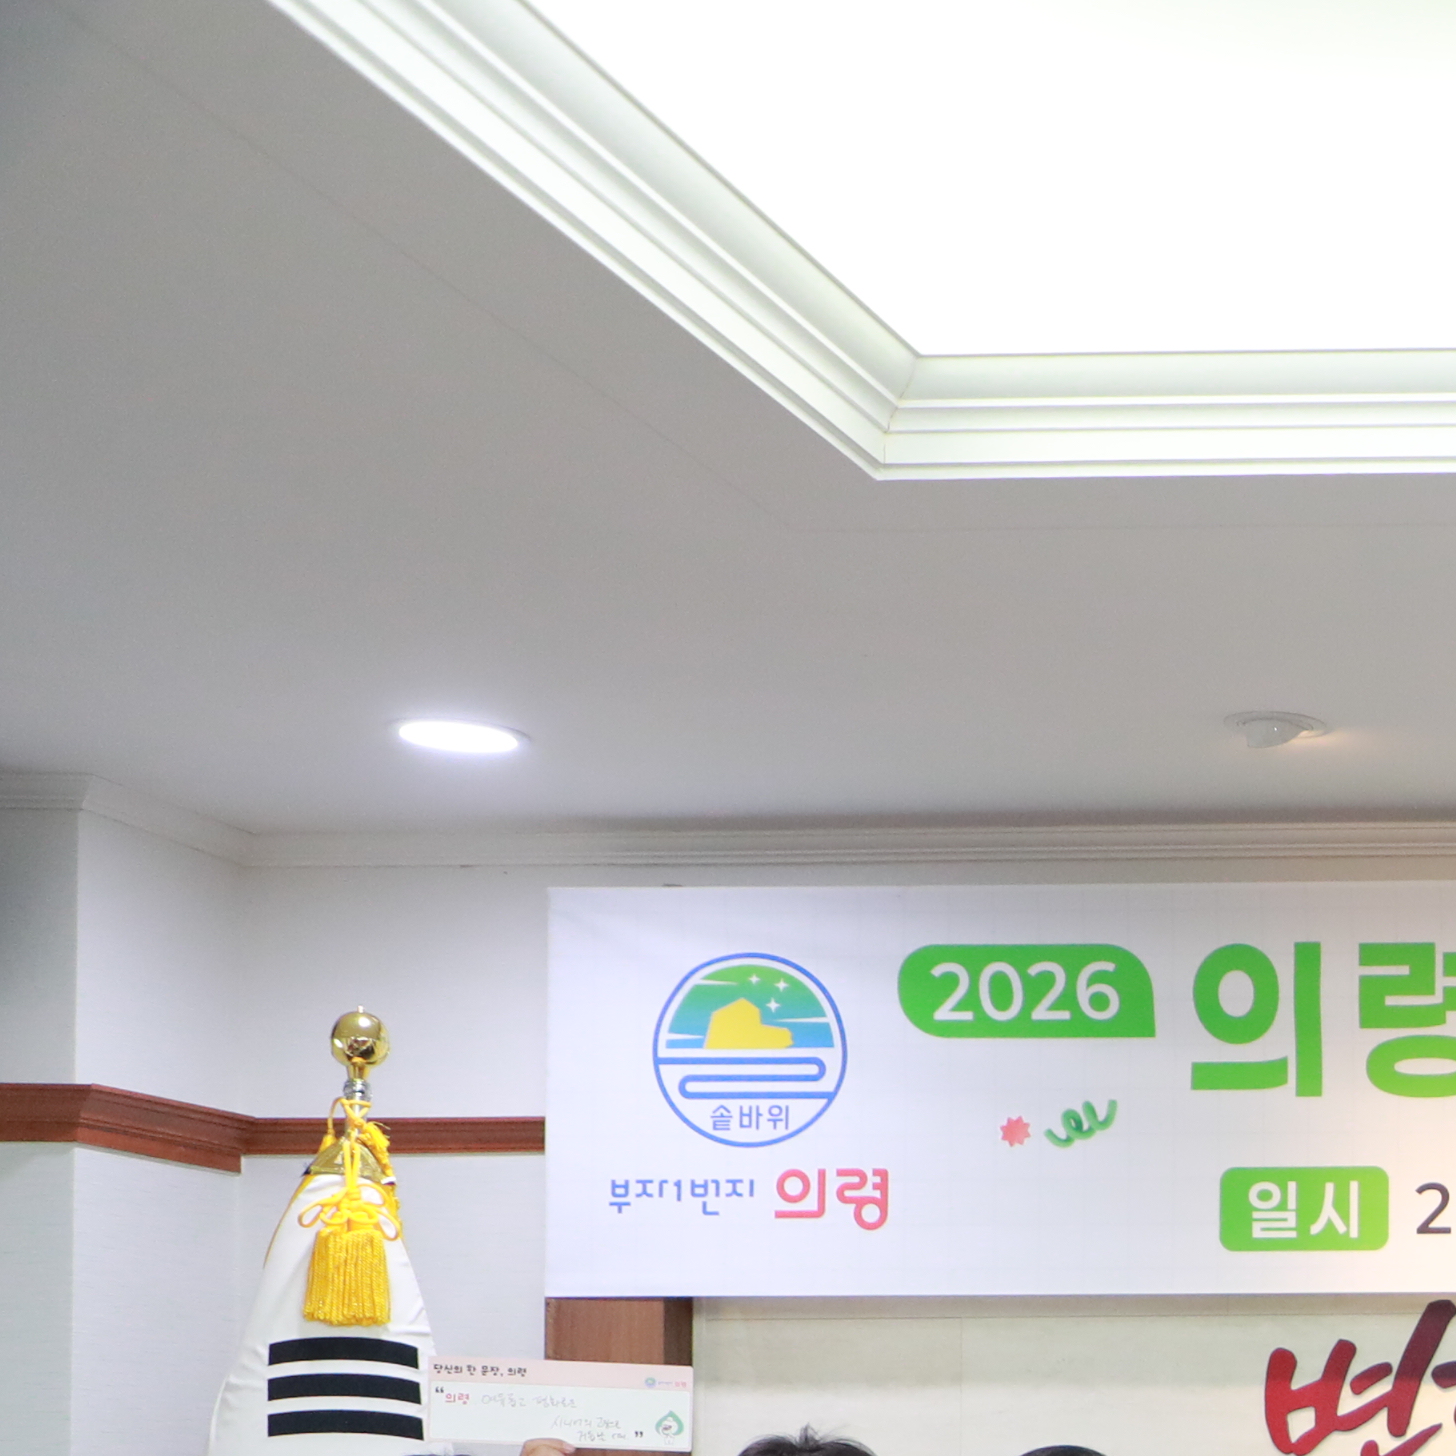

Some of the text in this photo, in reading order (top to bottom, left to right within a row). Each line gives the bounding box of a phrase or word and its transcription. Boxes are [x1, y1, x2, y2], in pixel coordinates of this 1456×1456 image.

[931, 961, 1121, 1023] 2026
[710, 1104, 790, 1131] 솥바위
[609, 1168, 889, 1231] 부자1번지 의령
[1246, 1184, 1362, 1241] 일시
[434, 1364, 527, 1377] 당신의 한 문장, 의령
[446, 1393, 469, 1404] 의령
